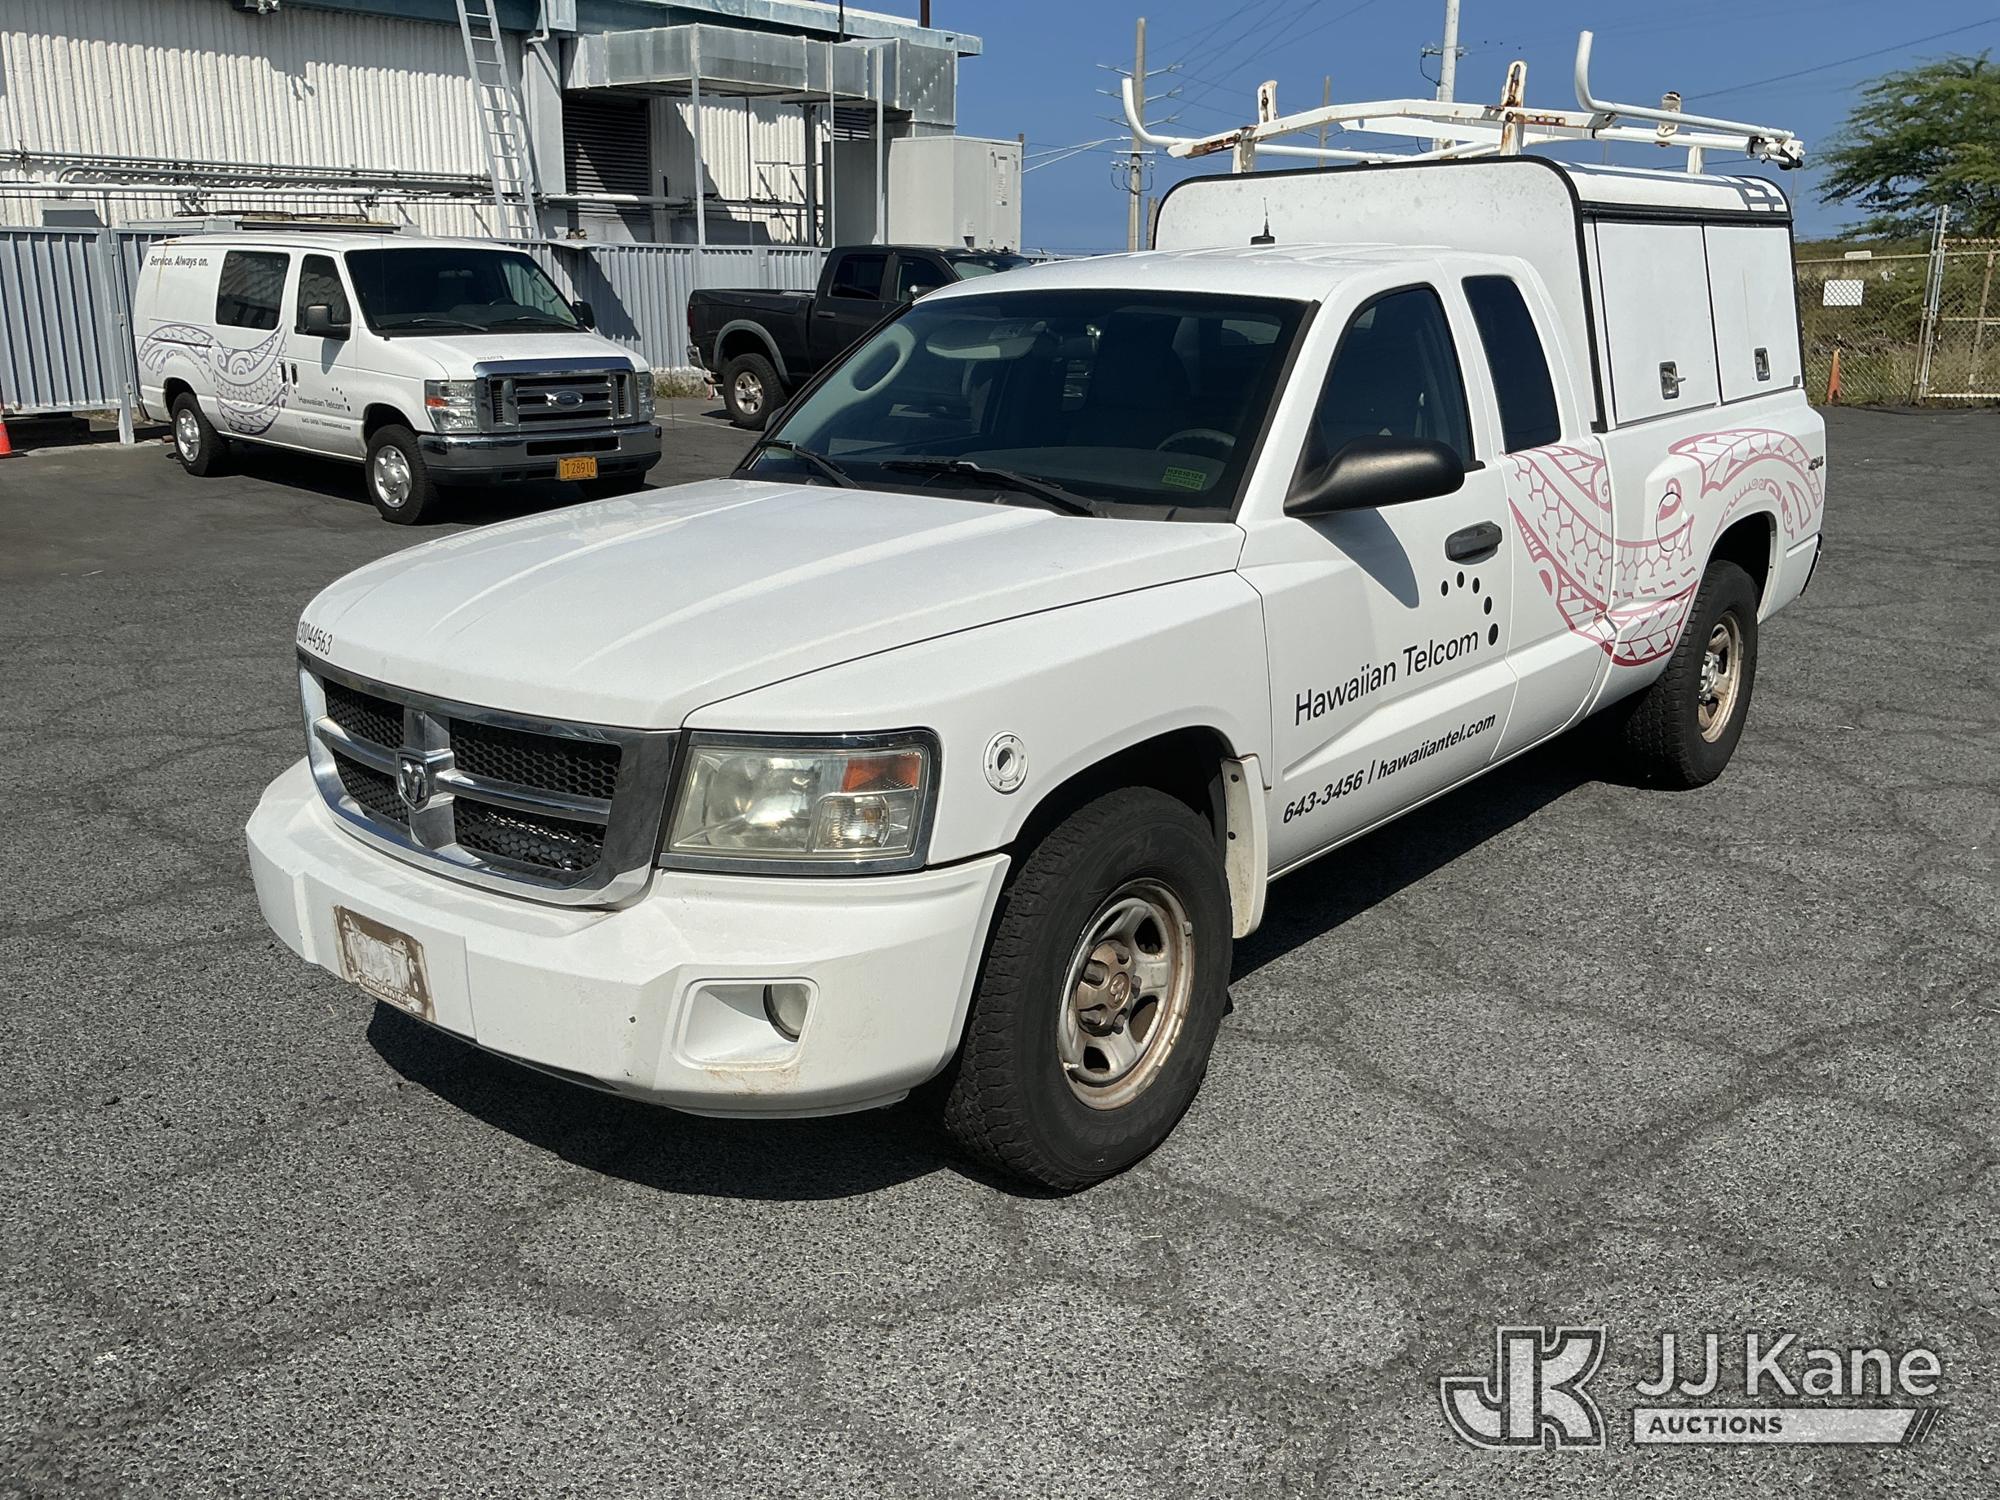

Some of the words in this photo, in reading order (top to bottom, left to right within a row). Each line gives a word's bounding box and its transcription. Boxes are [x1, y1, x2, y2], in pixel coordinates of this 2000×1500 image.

[174, 255, 197, 268] Always
[1294, 660, 1396, 726] Hawaiian
[1403, 631, 1479, 677] Telcom
[1282, 769, 1365, 824] 643-3456
[1377, 713, 1496, 780] hawaiiantel.com
